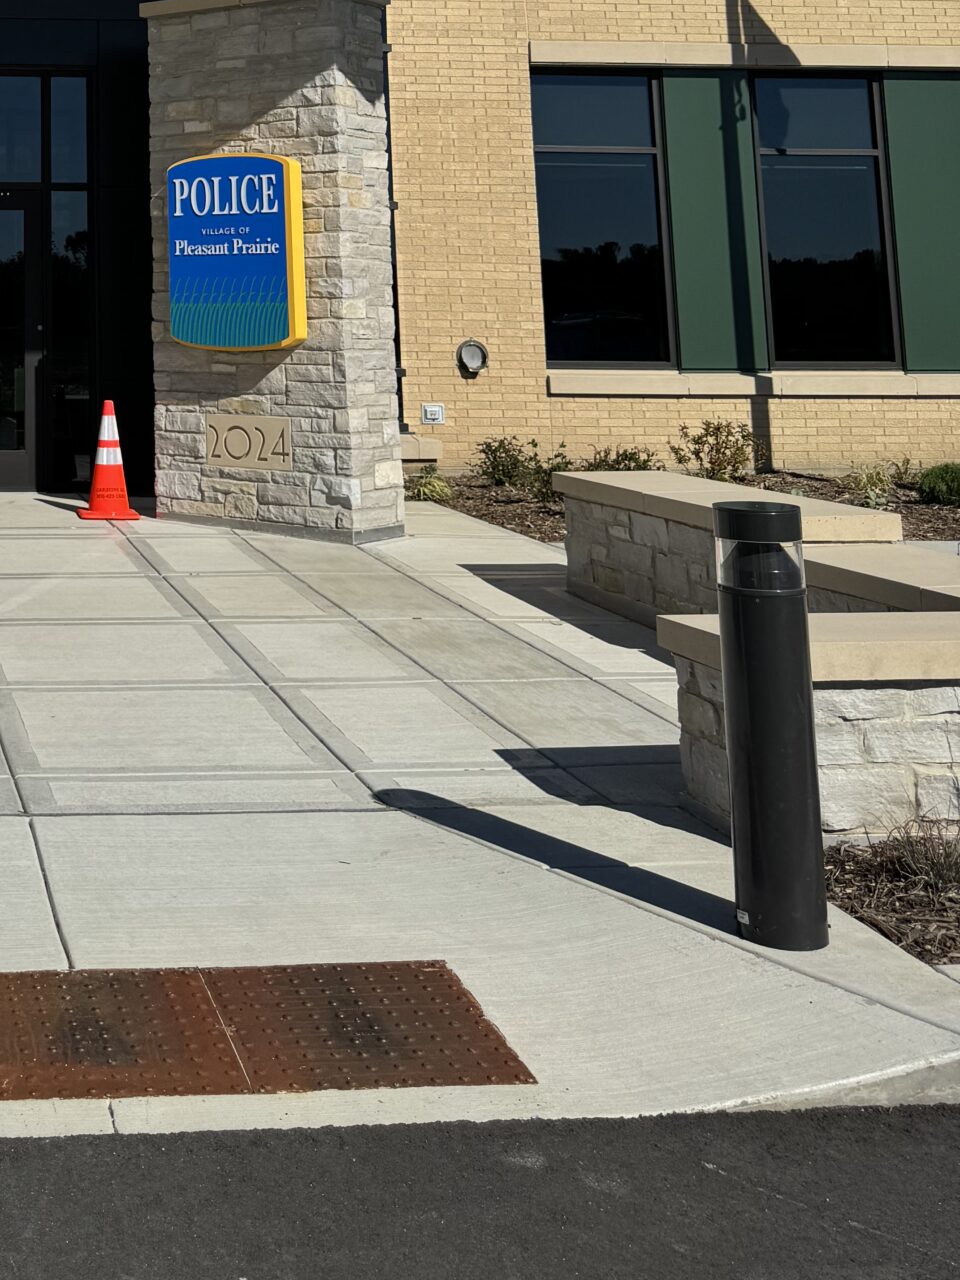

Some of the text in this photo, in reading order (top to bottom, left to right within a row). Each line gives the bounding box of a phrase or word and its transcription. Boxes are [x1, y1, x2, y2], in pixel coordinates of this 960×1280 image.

[173, 174, 279, 217] POLICE
[201, 226, 251, 236] VILLAGE OF
[174, 237, 280, 256] Pleasant Prairie
[208, 424, 290, 463] 2024
